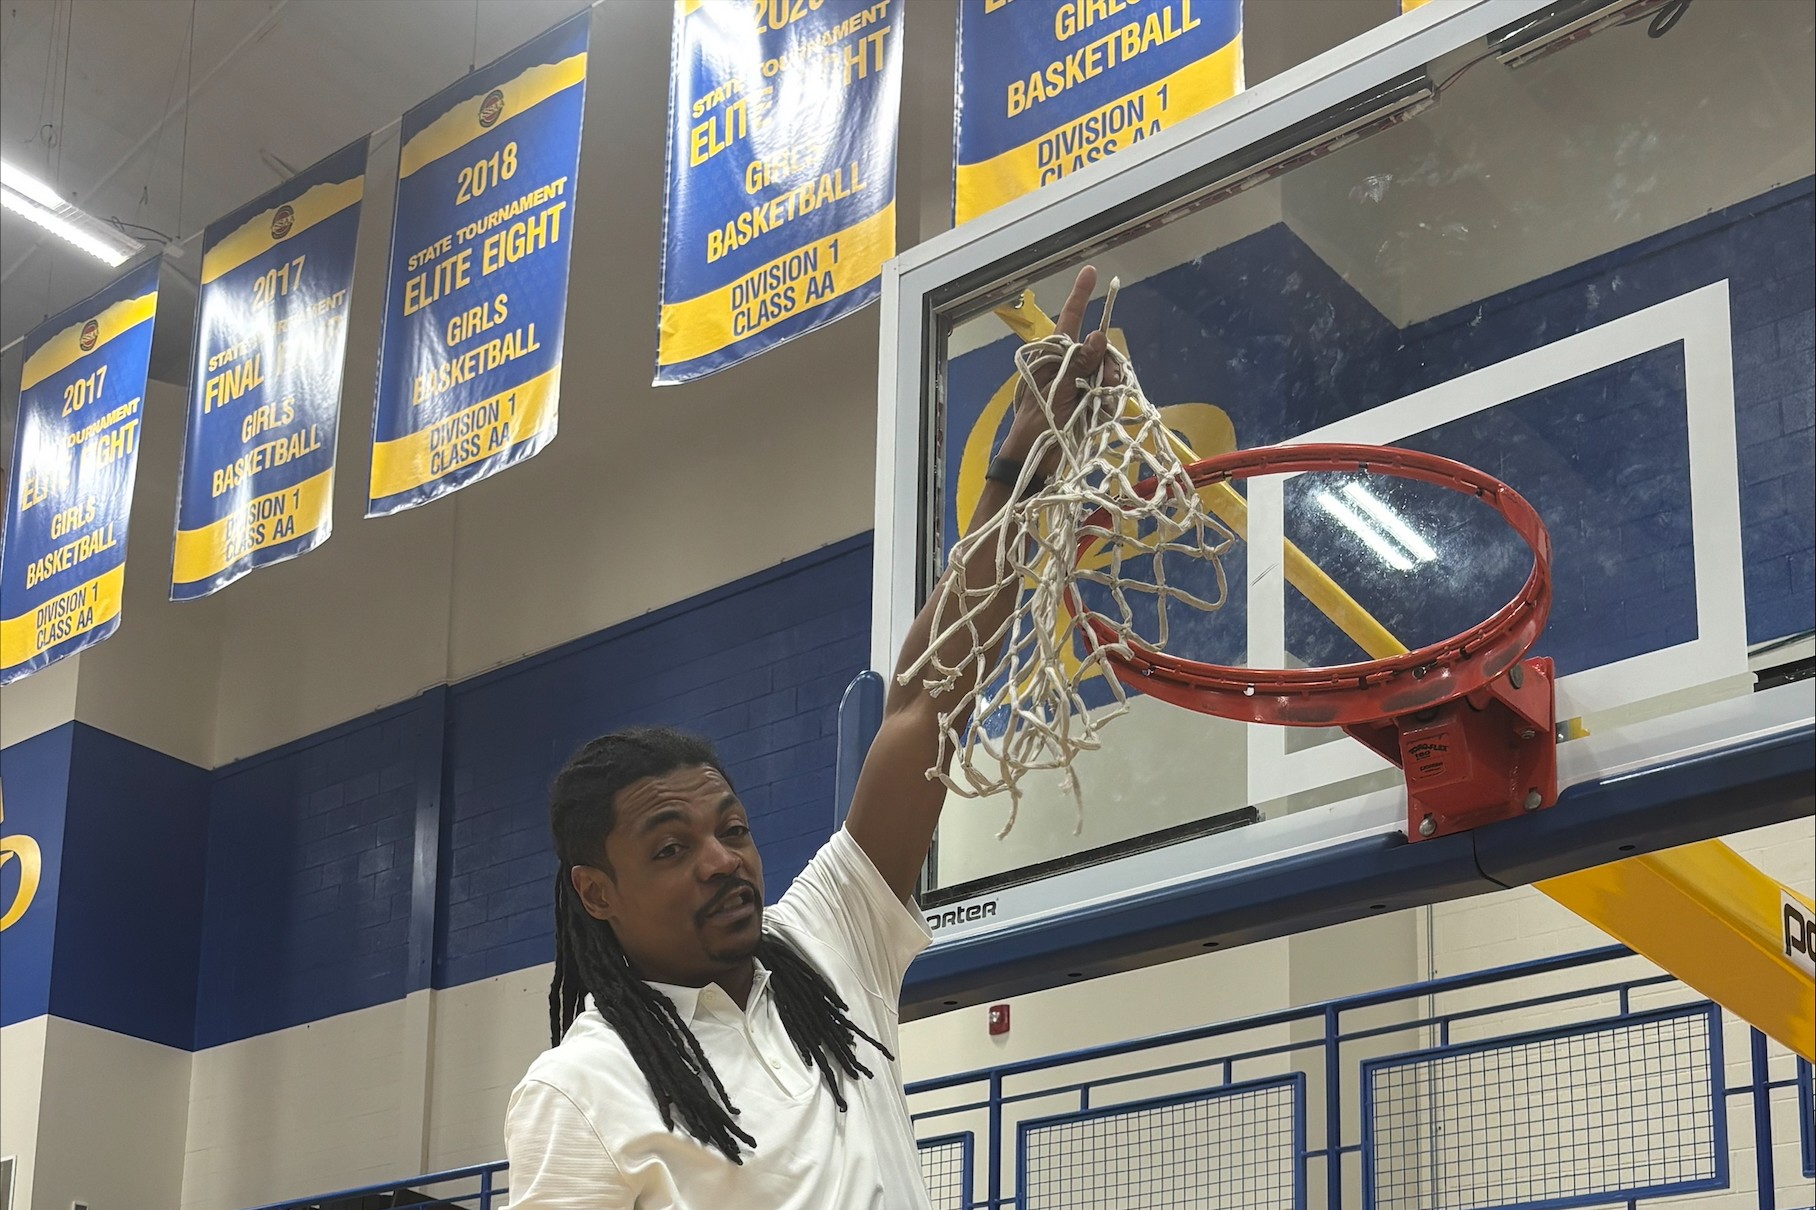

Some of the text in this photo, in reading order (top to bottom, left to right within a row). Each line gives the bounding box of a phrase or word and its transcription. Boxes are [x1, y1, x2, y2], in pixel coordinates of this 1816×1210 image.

[1055, 0, 1138, 42] GIRL
[1007, 0, 1201, 118] BASKETBALL
[1037, 83, 1168, 169] DIVISION 1
[456, 141, 517, 206] 2018
[408, 176, 567, 272] STATE TOURNAMENT
[707, 160, 867, 264] BASKETBALL
[251, 254, 306, 311] 2017
[404, 201, 566, 317] ELITE EIGHT
[731, 238, 839, 311] DIVISION 1
[446, 293, 508, 347] GIRLS
[732, 270, 835, 337] CLASS AA
[62, 365, 107, 418] 2017
[204, 353, 264, 414] FINAL
[412, 323, 540, 406] BASKETBALL
[241, 395, 295, 444] GIRLS
[430, 393, 516, 452] DIVISION 1
[430, 422, 510, 476] CLASS AA
[212, 423, 321, 498] BASKETBALL
[51, 496, 96, 540] GIRLS
[272, 515, 294, 540] AA
[293, 489, 300, 510] 1
[26, 521, 117, 590] BASKETBALL
[36, 581, 98, 629] DIVISION 1
[36, 606, 93, 650] CLASS AA
